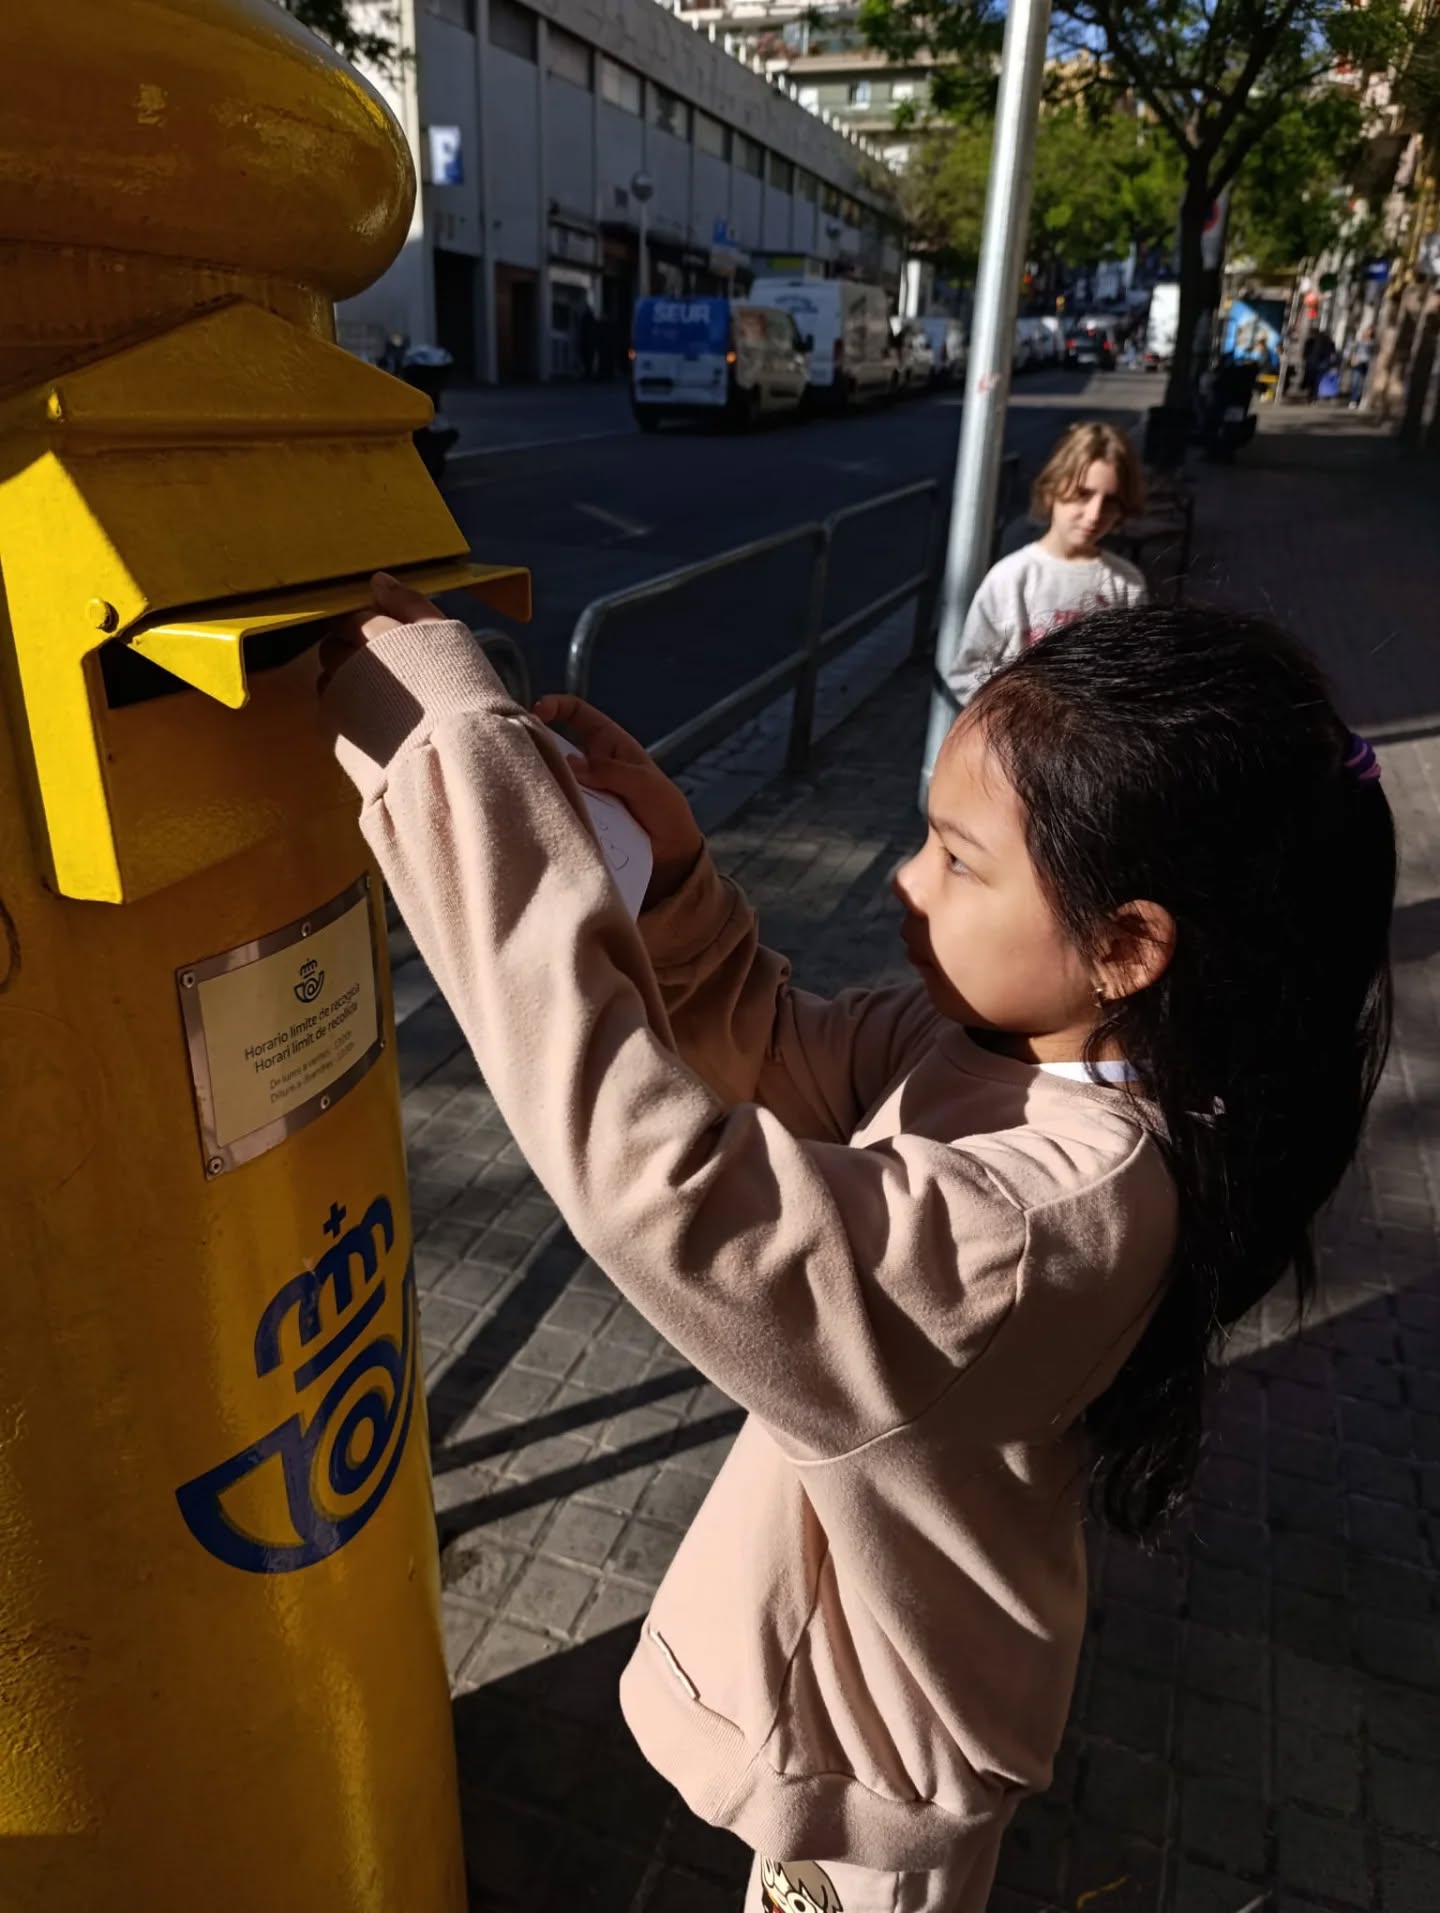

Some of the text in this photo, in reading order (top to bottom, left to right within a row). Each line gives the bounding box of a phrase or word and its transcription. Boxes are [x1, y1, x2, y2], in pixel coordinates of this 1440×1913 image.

[428, 125, 461, 186] P
[652, 303, 711, 325] SEUR
[244, 1032, 288, 1060] Horario
[319, 1007, 330, 1020] de
[255, 1044, 290, 1073] Horari
[315, 1026, 326, 1040] de
